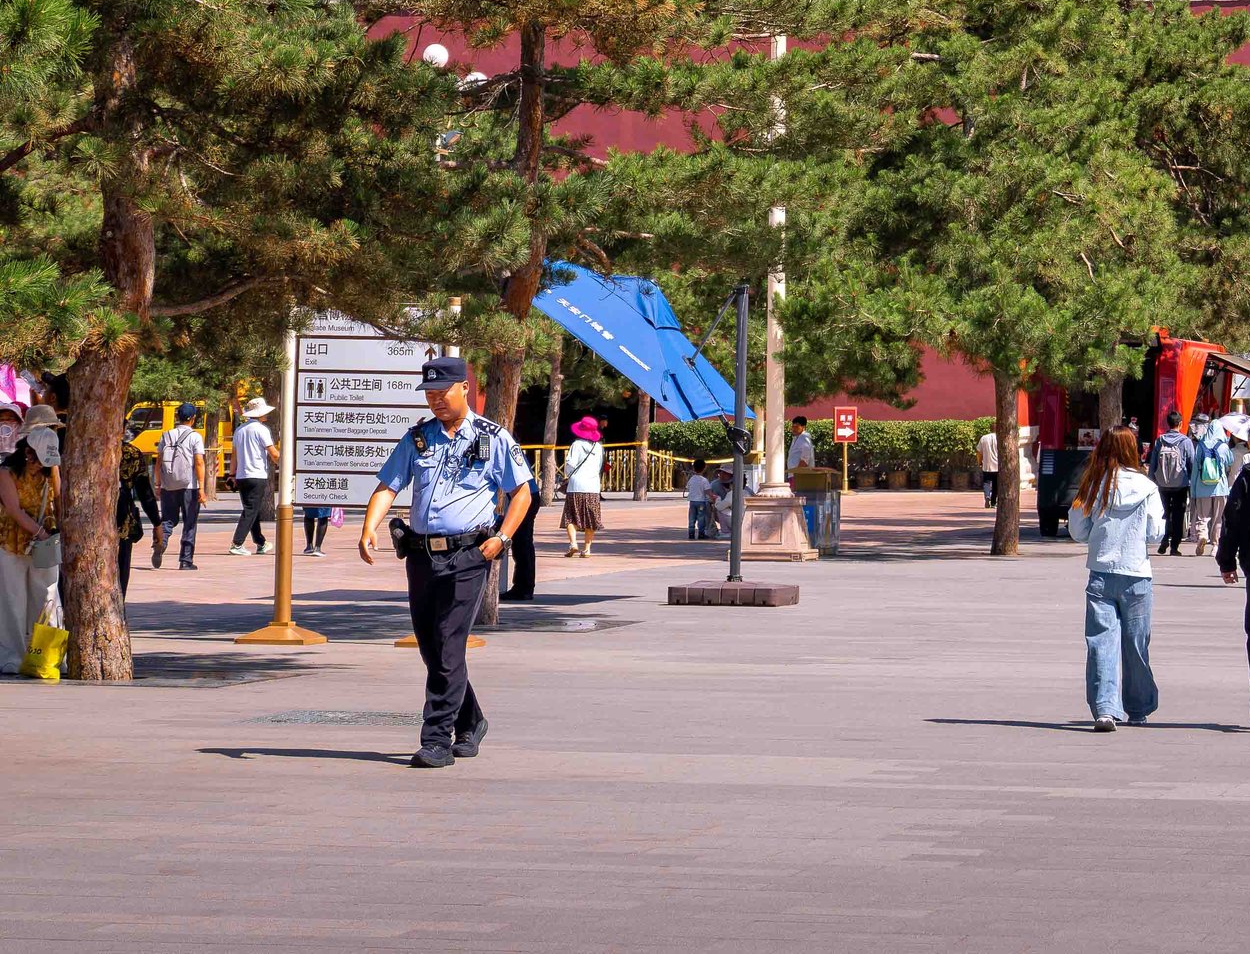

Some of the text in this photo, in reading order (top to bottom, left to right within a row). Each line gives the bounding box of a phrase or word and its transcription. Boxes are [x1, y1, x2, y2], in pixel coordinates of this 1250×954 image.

[328, 324, 355, 332] Museum
[305, 342, 414, 356] 出口 365m
[304, 358, 318, 366] Exit
[329, 378, 412, 391] 公共卫生间 168m
[329, 393, 365, 402] Public Toilet
[303, 411, 410, 425] 天安门城楼存包处 120m
[347, 427, 369, 436] Baggage
[369, 428, 388, 436] Deposit
[303, 444, 386, 458] 天安门城楼服务处
[349, 460, 369, 468] Service
[303, 477, 349, 491] 安检通道
[303, 492, 348, 501] Security Check
